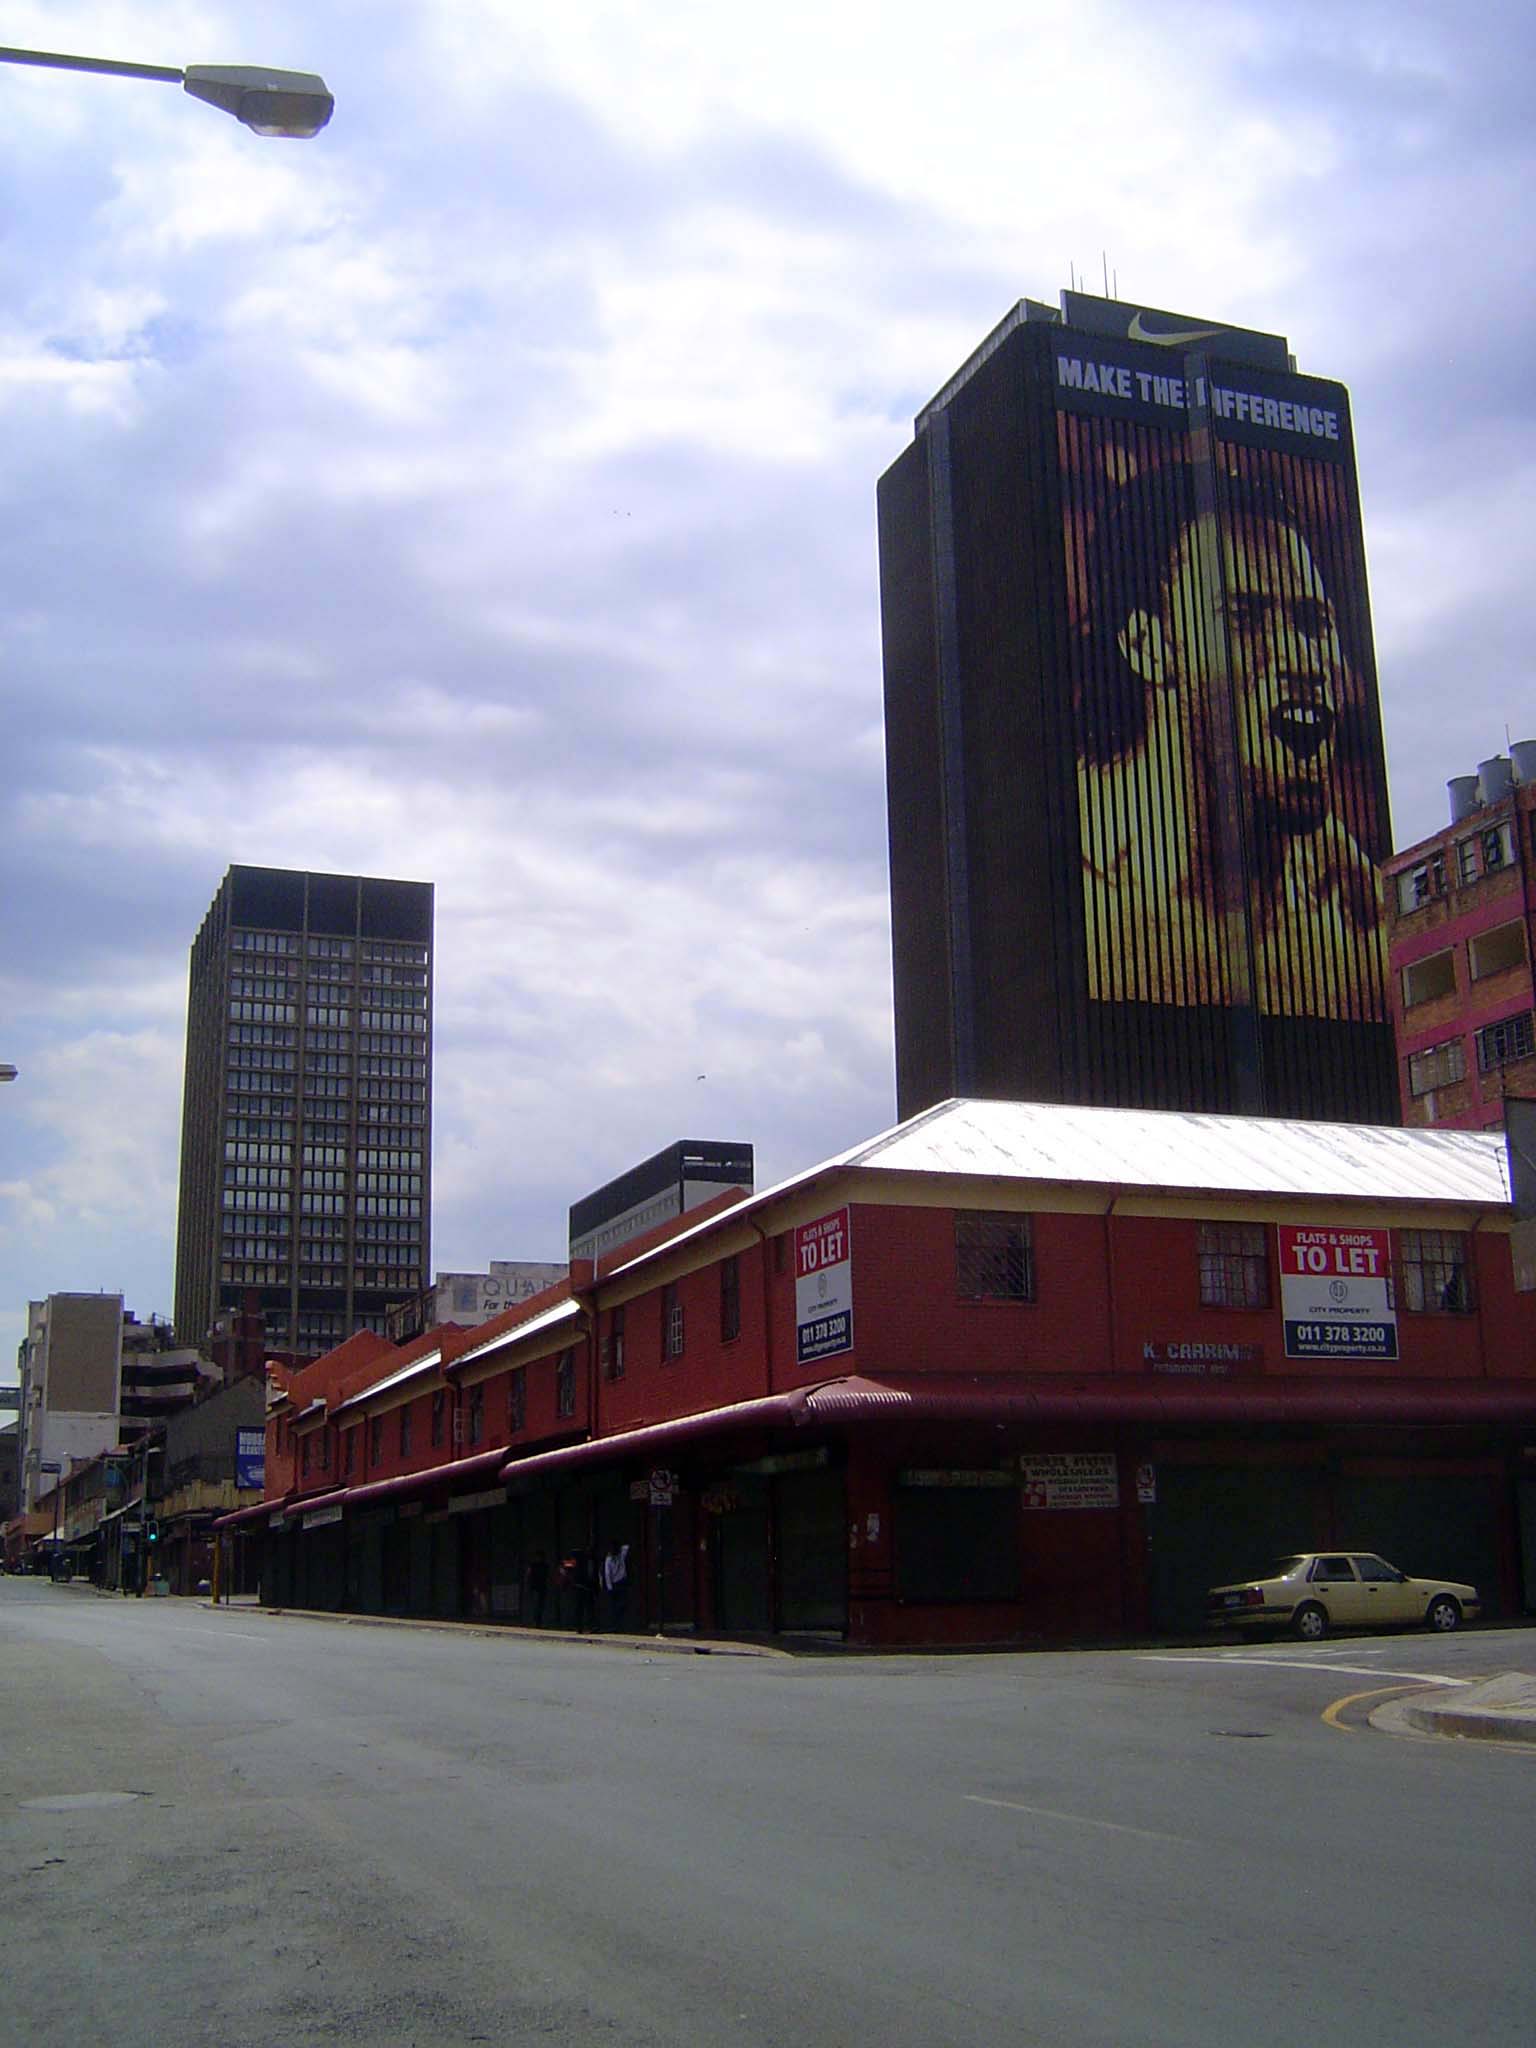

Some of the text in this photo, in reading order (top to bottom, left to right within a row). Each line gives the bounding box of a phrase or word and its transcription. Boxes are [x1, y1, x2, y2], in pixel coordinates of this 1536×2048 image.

[1057, 356, 1132, 398] MAKE
[1136, 372, 1192, 409] THE
[1296, 1232, 1373, 1246] FLATS & SHOPS
[800, 1231, 843, 1272] TO LET
[1292, 1245, 1379, 1274] TO LET
[1328, 1306, 1371, 1314] PROPERTY
[1296, 1325, 1385, 1342] 011 378 3200
